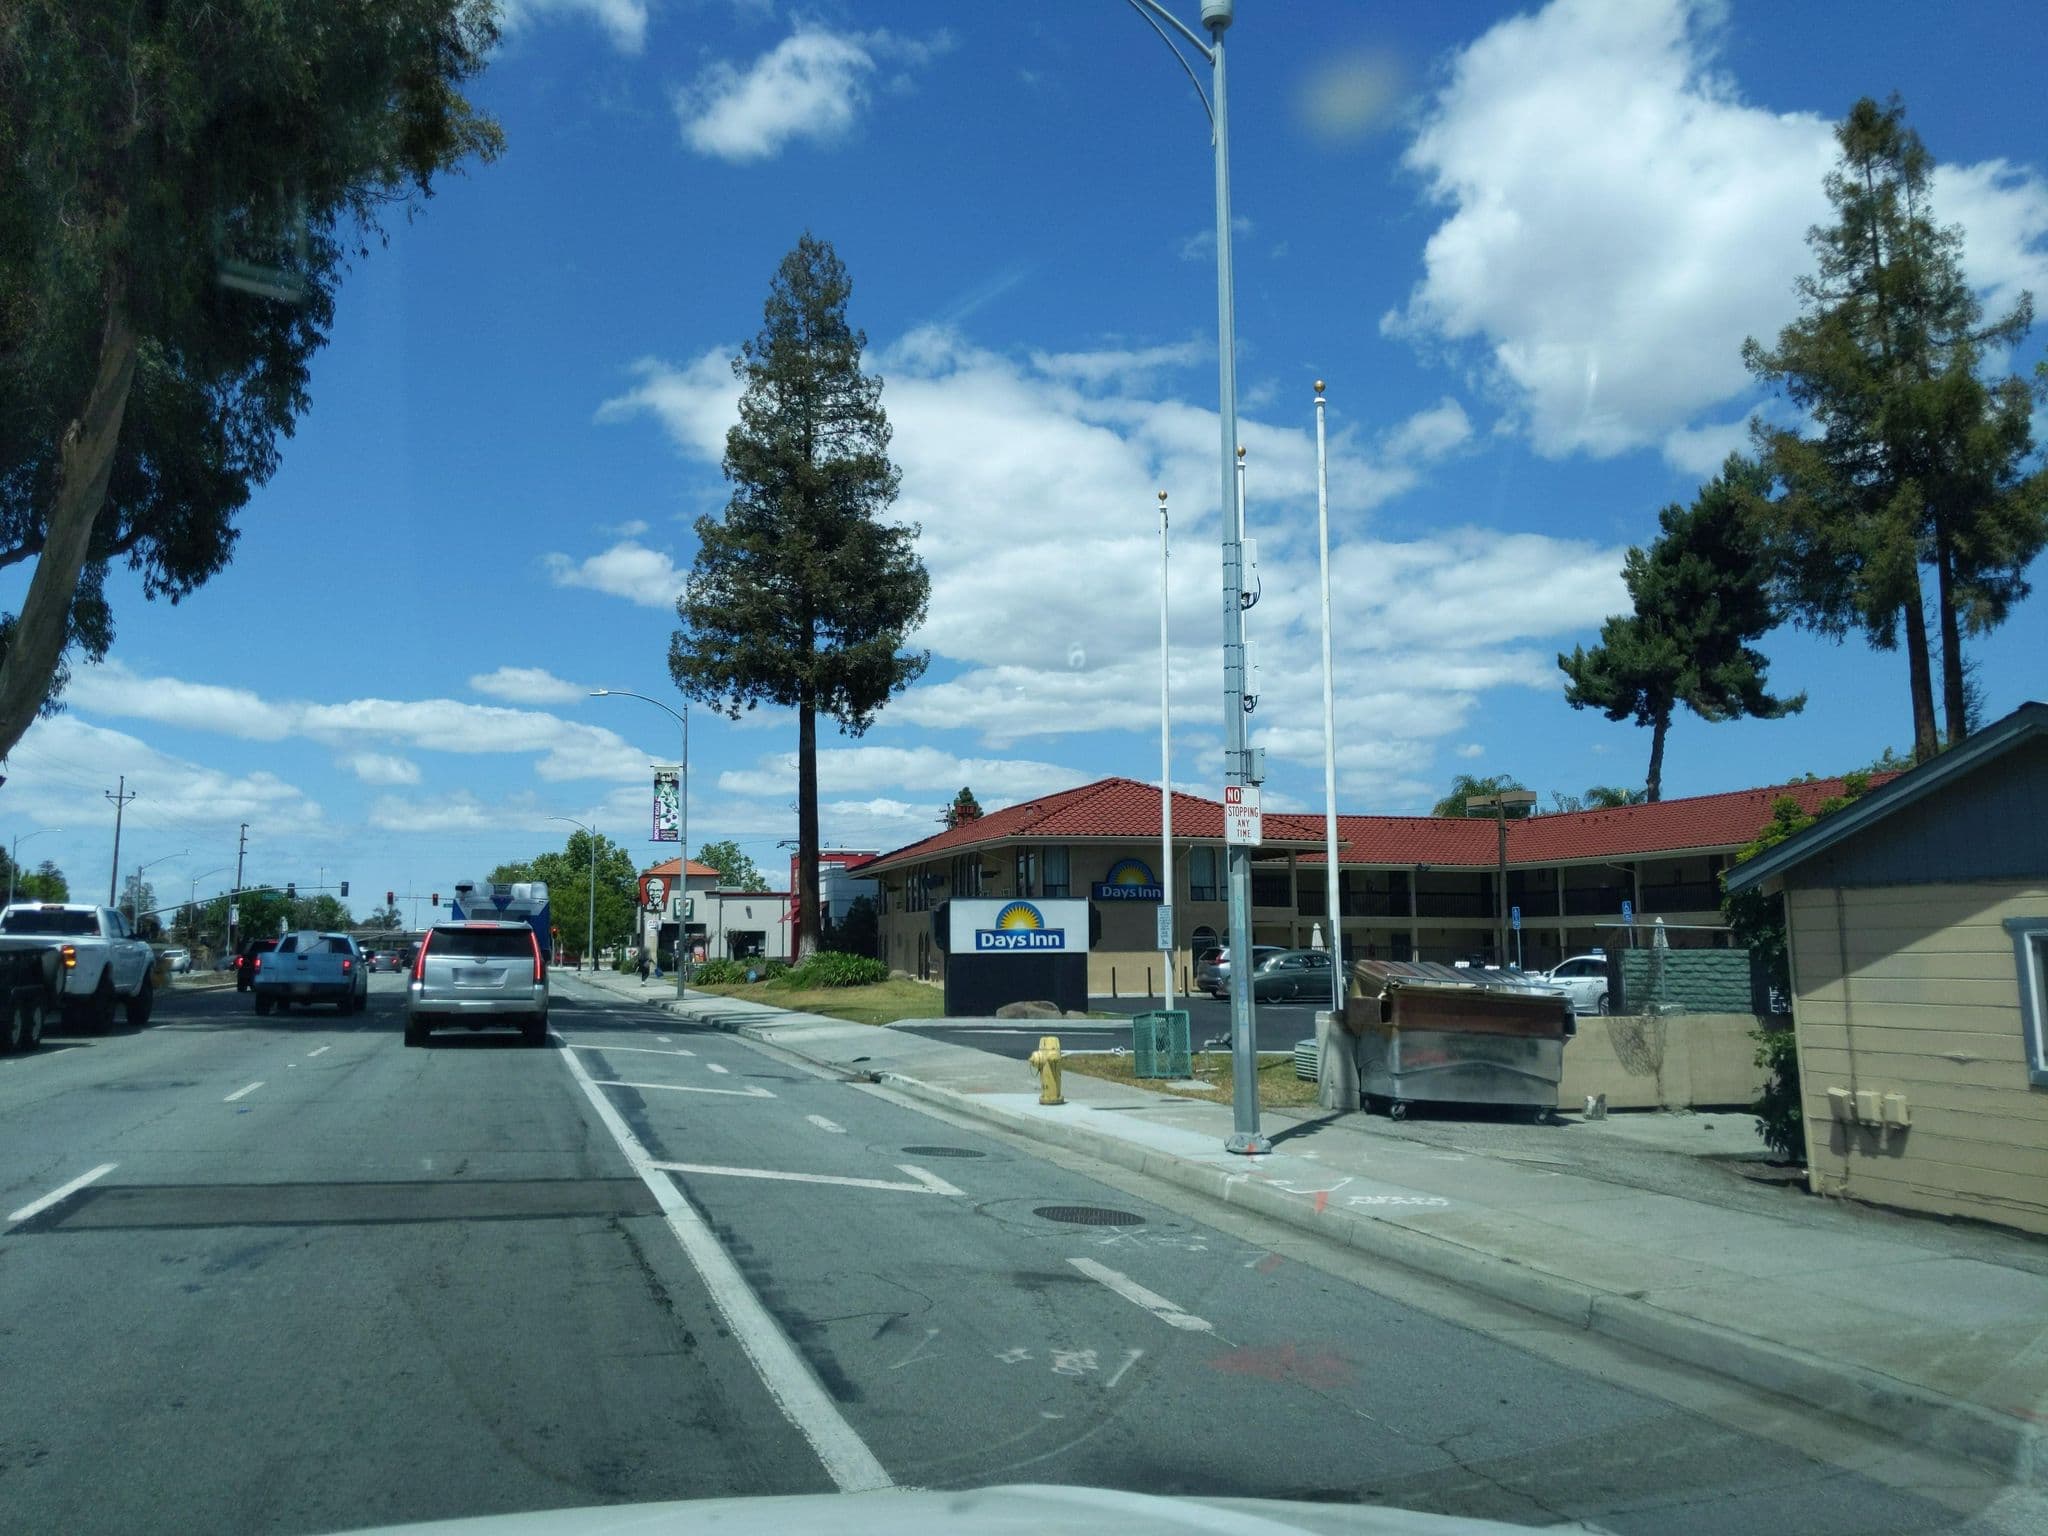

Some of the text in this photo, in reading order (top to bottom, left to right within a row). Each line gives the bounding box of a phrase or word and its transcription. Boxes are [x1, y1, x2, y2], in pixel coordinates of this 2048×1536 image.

[1227, 788, 1240, 802] NO
[1228, 806, 1258, 818] STOPPING
[1237, 819, 1250, 828] ANY
[1237, 829, 1251, 838] TIME
[1102, 886, 1161, 900] Days Inn
[981, 932, 1060, 949] Days Inn
